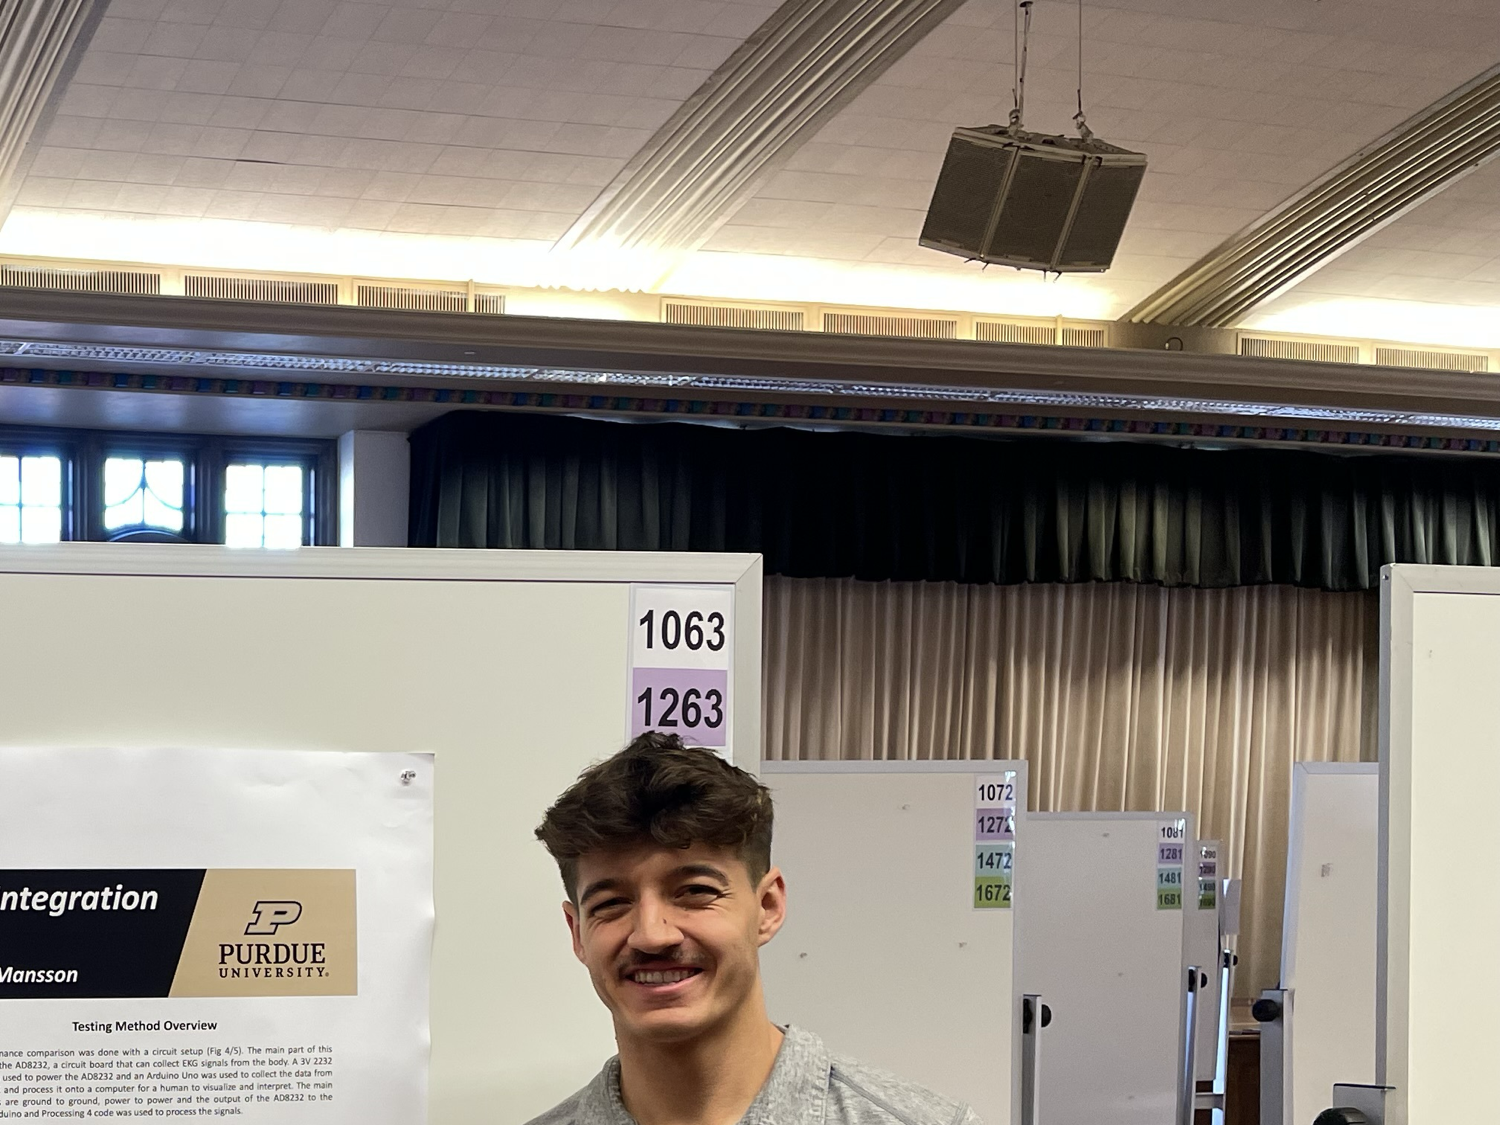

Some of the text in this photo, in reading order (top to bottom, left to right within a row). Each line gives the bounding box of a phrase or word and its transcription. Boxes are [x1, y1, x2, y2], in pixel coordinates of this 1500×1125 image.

[639, 609, 726, 652] 1063
[637, 687, 723, 729] 1263
[978, 784, 1013, 801] 1072
[977, 852, 1012, 869] 1472
[1160, 848, 1182, 860] 1281
[1159, 872, 1181, 884] 1481
[976, 884, 1011, 901] 1672
[1158, 893, 1181, 906] 1681
[218, 943, 326, 965] PURDUE
[71, 1020, 217, 1033] Testing Method Overview
